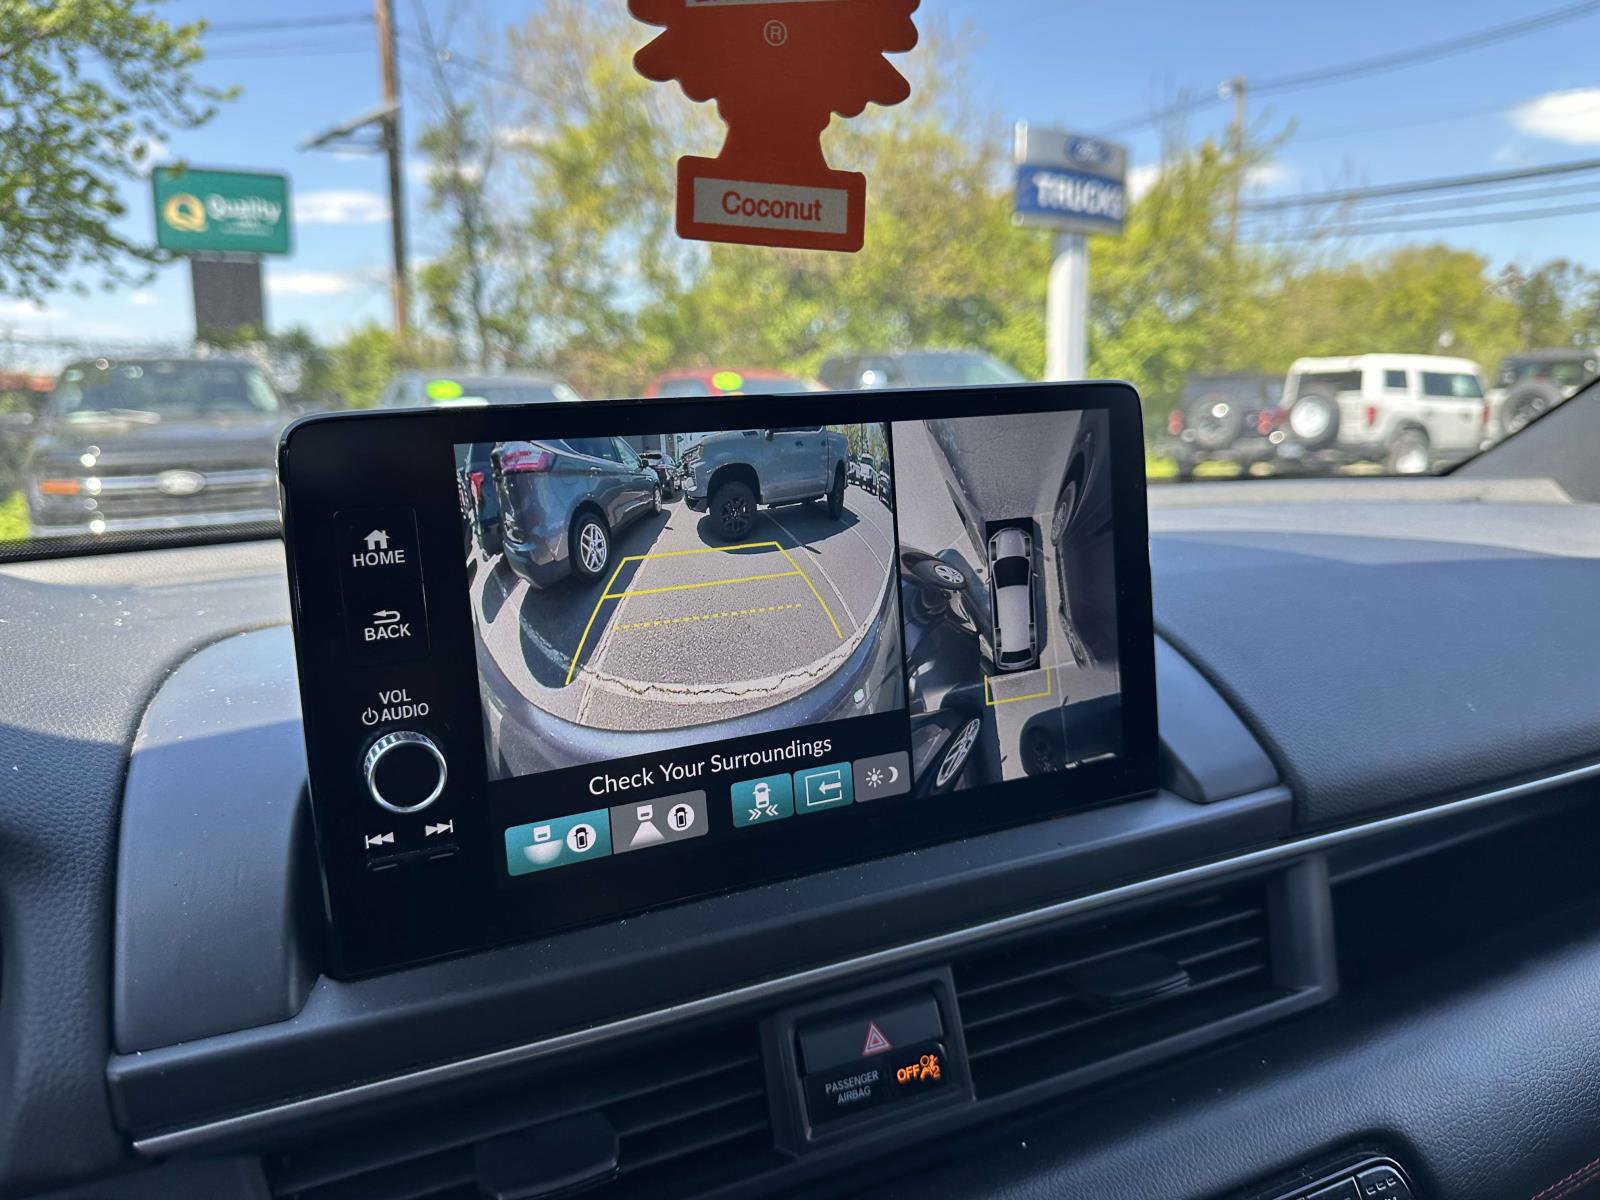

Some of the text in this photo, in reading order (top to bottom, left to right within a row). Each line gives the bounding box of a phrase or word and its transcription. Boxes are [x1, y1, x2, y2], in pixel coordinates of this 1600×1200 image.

[205, 193, 282, 226] Quality
[721, 191, 823, 222] Coconut
[352, 549, 406, 567] HOME
[364, 623, 412, 641] BACK
[379, 689, 412, 705] VOL
[380, 702, 430, 722] AUDIO
[588, 737, 833, 796] Check Your Surroundings
[825, 1070, 879, 1094] PASSENGER
[896, 1063, 920, 1083] OFF
[837, 1085, 872, 1104] AIRBAG
